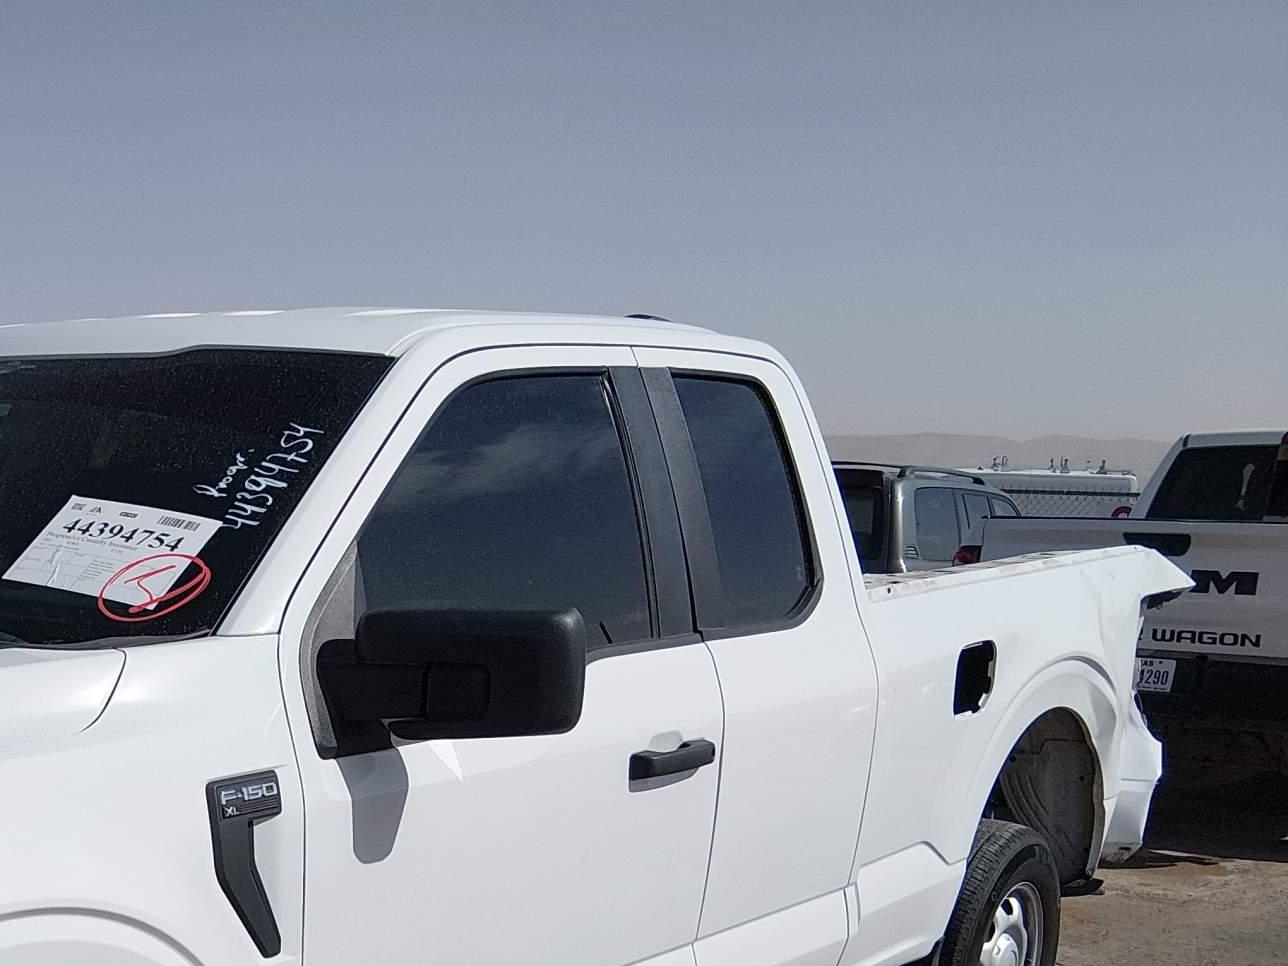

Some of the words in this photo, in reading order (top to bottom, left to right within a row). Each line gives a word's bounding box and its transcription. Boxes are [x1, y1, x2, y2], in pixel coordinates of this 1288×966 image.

[219, 422, 325, 529] 44394754
[62, 518, 185, 552] 44394754
[1152, 627, 1262, 648] WAGON
[220, 782, 279, 805] F-150
[225, 806, 241, 817] XL
